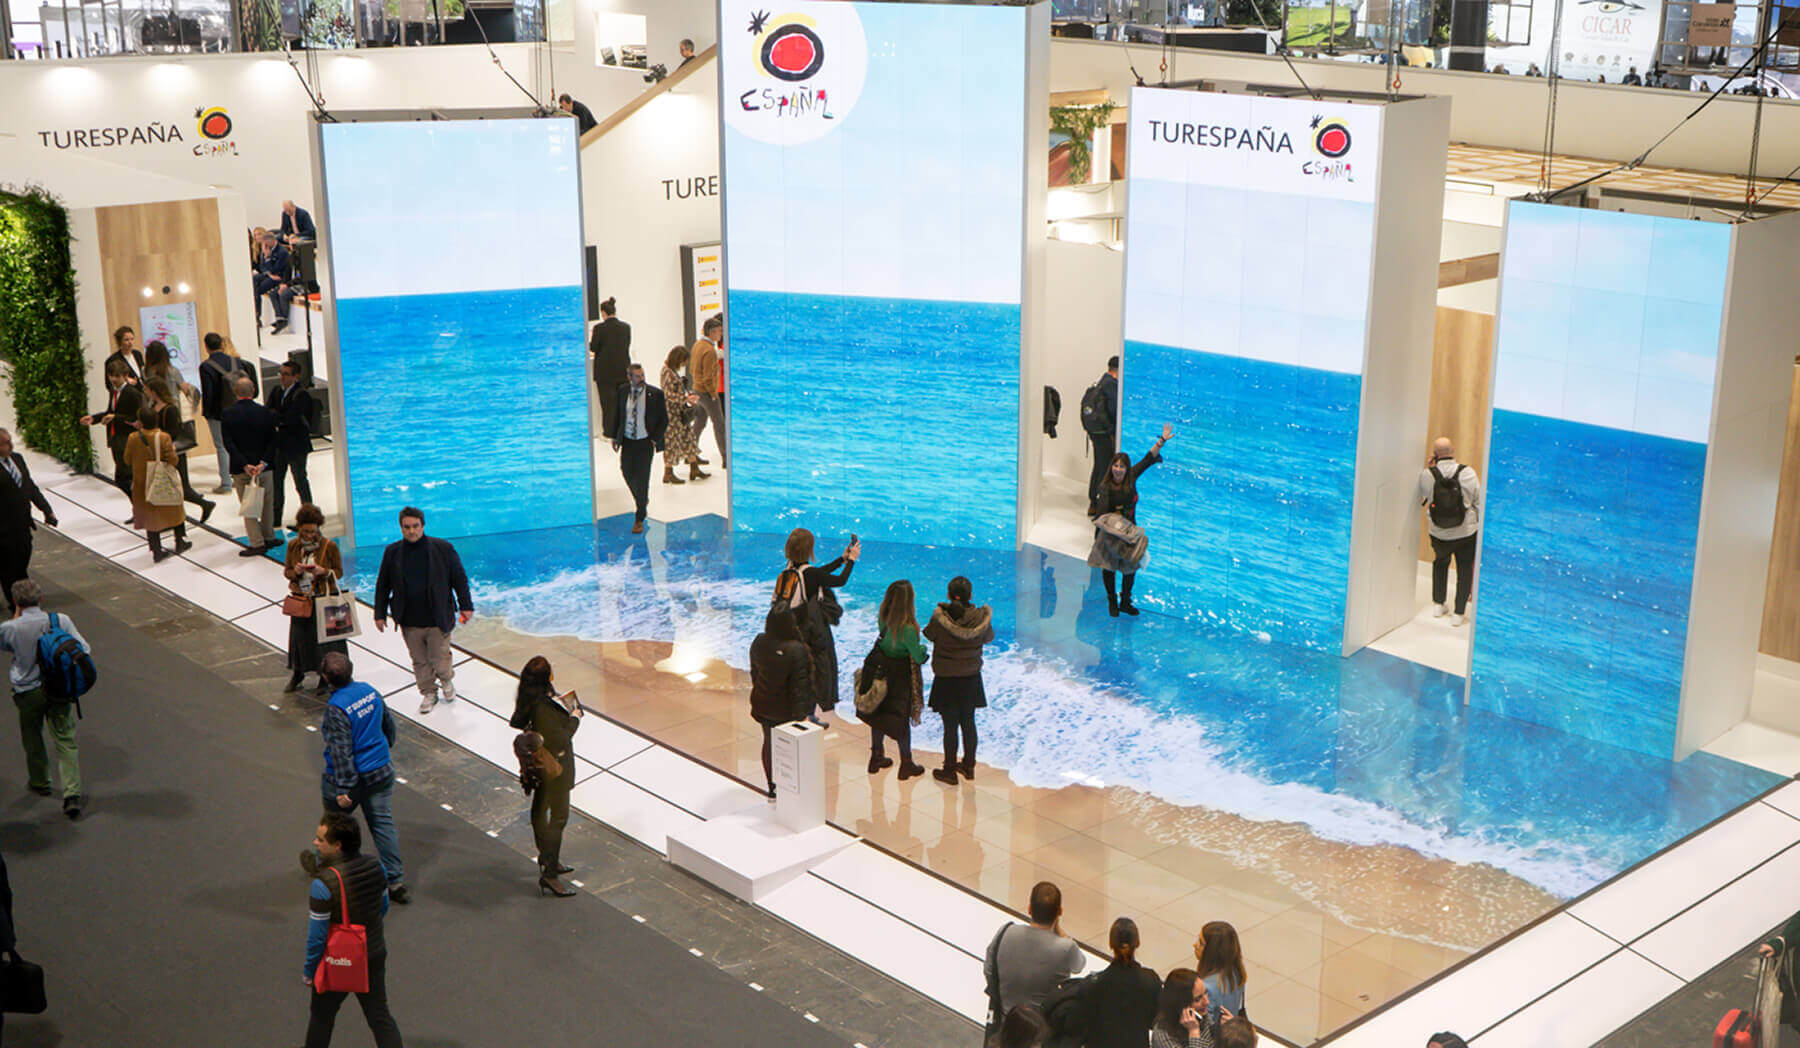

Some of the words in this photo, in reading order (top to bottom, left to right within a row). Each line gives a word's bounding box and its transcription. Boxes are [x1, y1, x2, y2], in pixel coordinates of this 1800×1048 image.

[1582, 16, 1632, 34] CICAR
[38, 121, 184, 149] TURESPAÑA
[1149, 120, 1293, 154] TURESPAÑA
[352, 692, 377, 710] SUPPORT
[357, 704, 375, 719] STAFF
